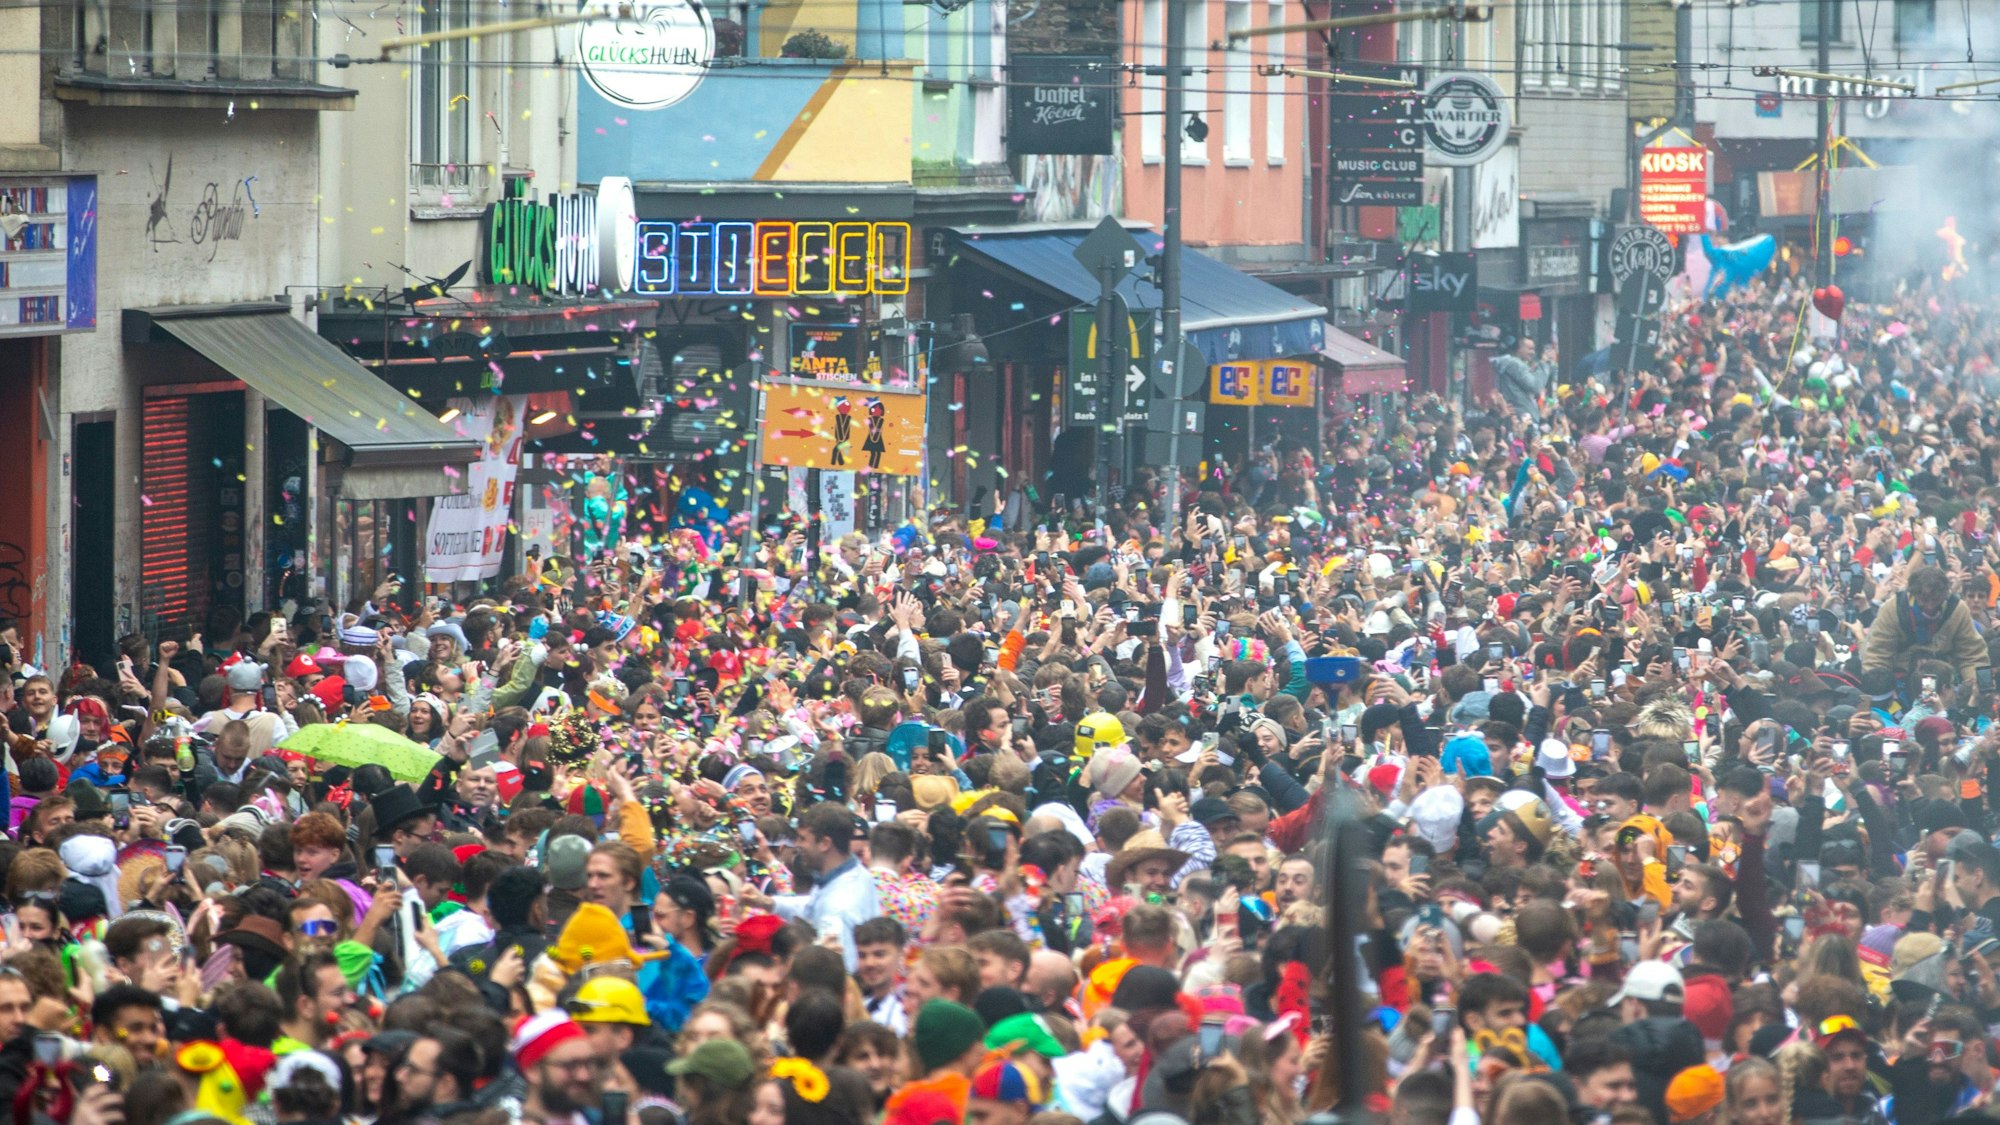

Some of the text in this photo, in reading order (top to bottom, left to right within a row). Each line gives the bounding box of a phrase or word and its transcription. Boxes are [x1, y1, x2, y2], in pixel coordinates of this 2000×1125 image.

[588, 41, 698, 66] GLÜCKSHUHN
[1032, 105, 1086, 126] Kölsch
[1337, 160, 1417, 172] MUSIC CLUB
[1641, 152, 1705, 173] KIOSK
[490, 176, 599, 297] GLÜCKSHUHN
[1614, 228, 1670, 254] FRISEUR
[639, 228, 905, 286] STIEFEL
[1416, 265, 1469, 298] sky
[791, 357, 850, 374] FANTA
